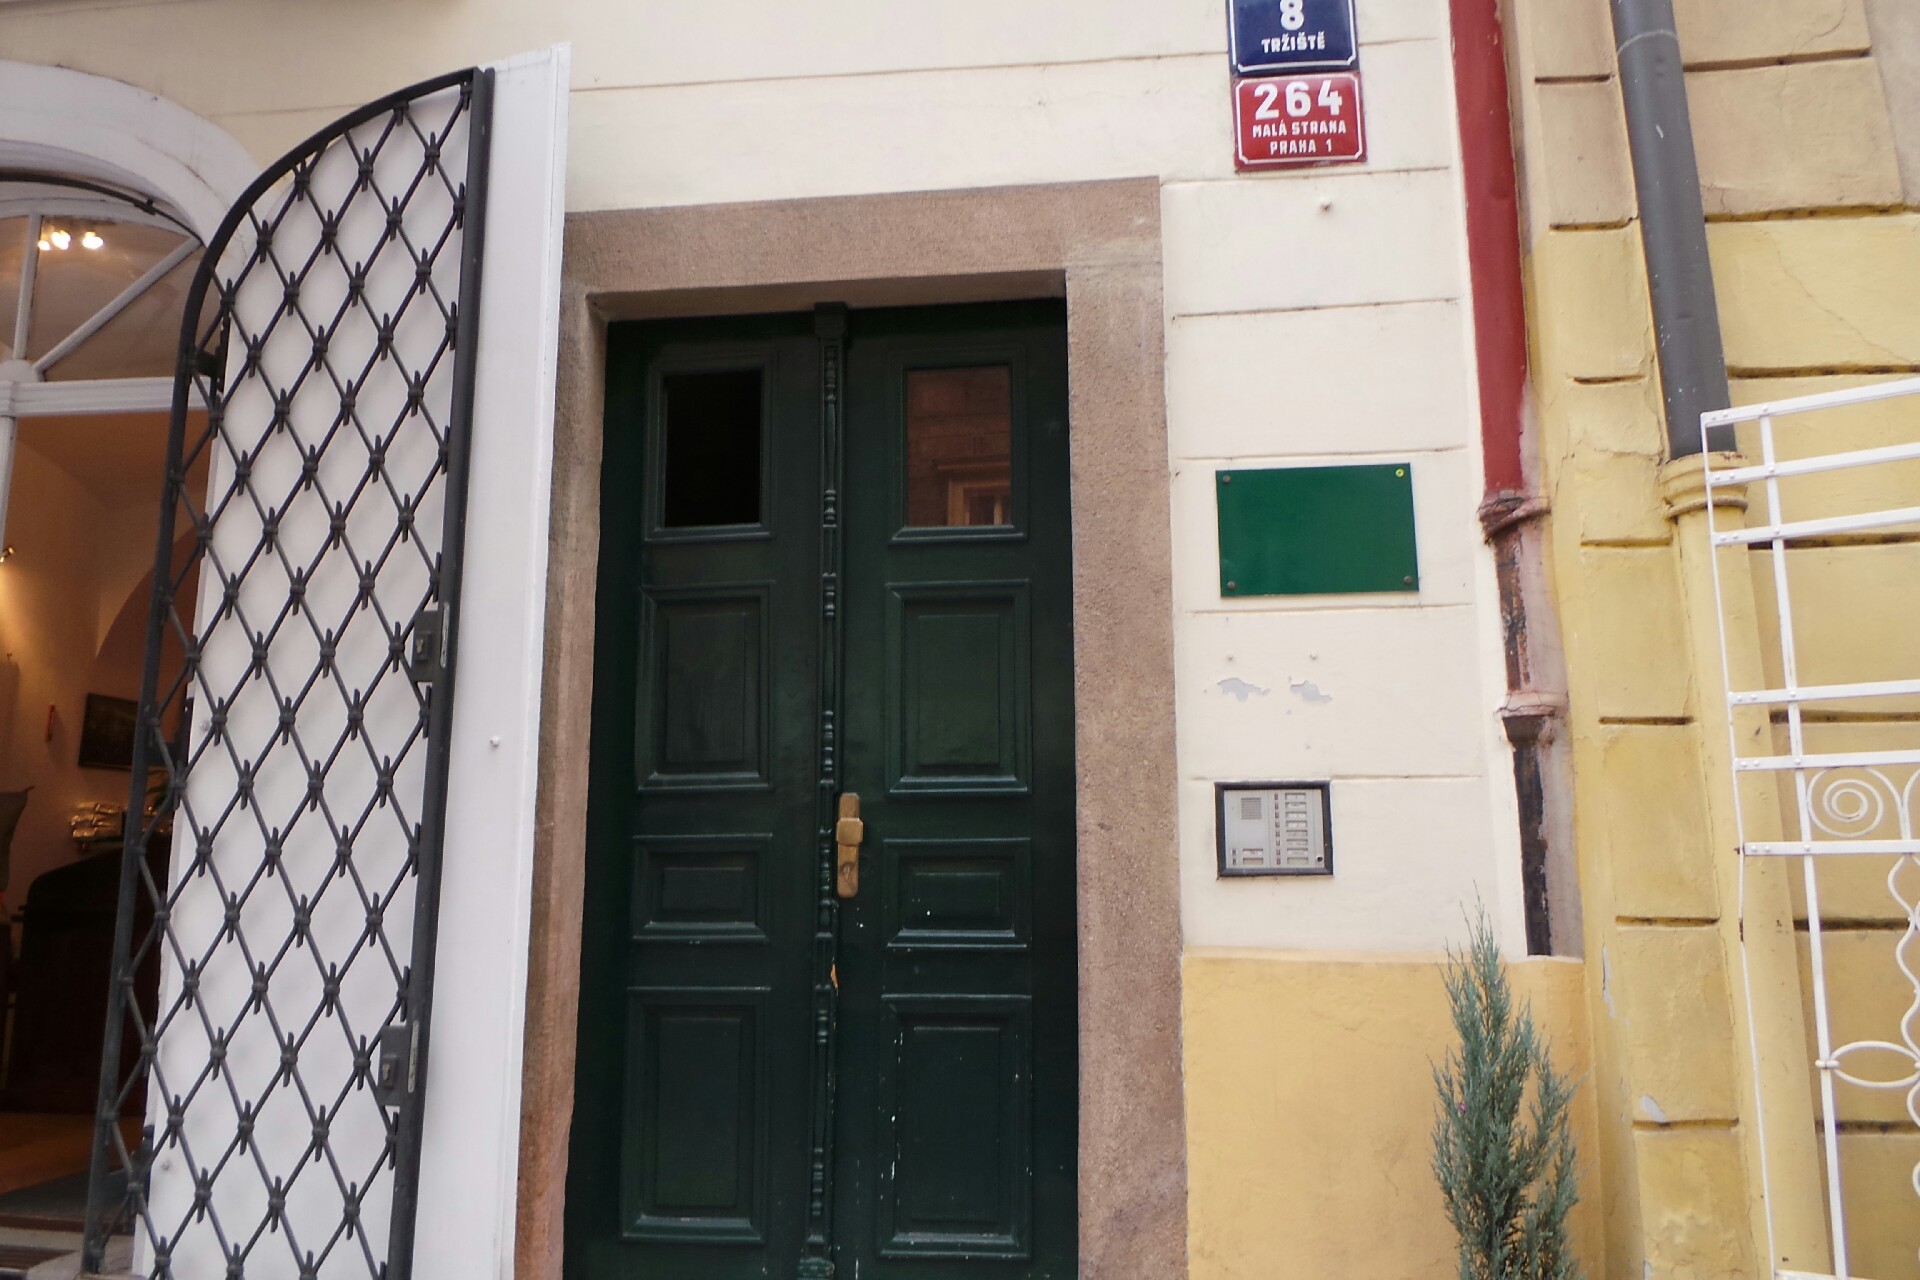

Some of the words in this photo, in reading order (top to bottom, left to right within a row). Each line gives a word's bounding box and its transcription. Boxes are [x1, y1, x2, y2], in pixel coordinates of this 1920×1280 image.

[1280, 0, 1304, 31] 8
[1261, 31, 1326, 53] TRŽIŠTĚ
[1253, 80, 1343, 120] 264
[1252, 120, 1288, 138] MALÁ
[1291, 120, 1347, 136] STRANA
[1269, 140, 1317, 155] PRAHA
[1325, 139, 1333, 153] 1
